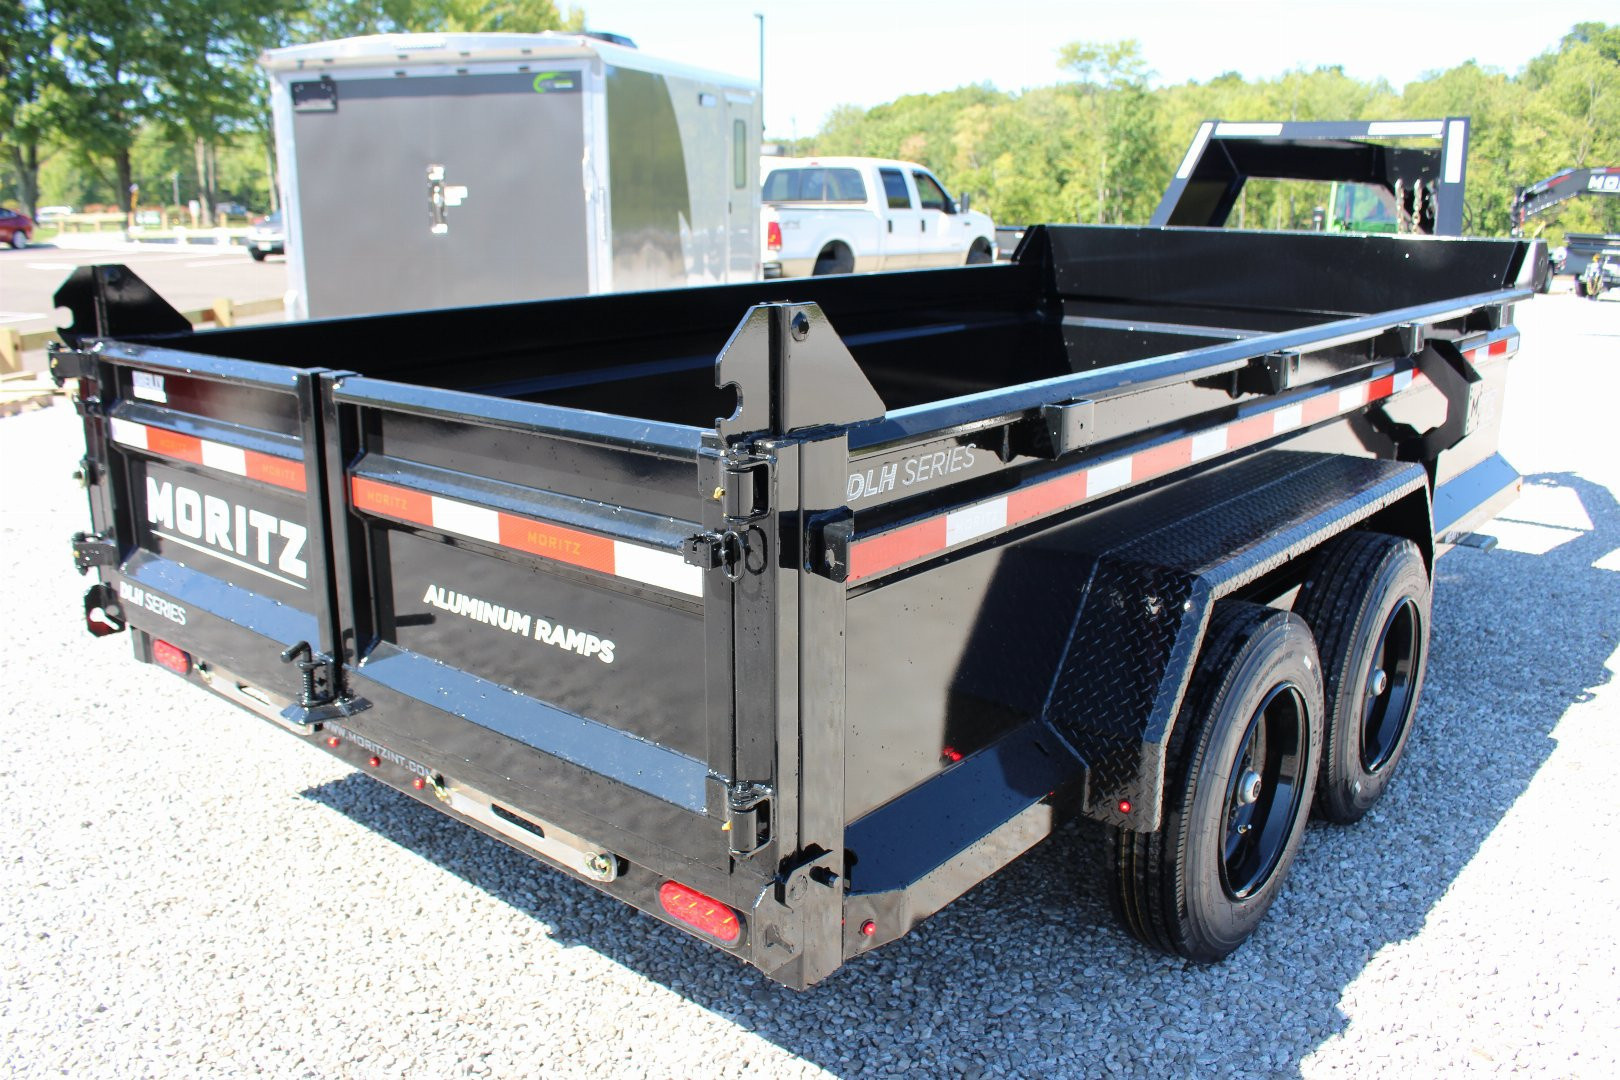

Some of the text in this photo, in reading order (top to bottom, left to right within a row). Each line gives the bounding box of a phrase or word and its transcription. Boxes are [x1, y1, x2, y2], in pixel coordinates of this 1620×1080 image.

[1587, 174, 1620, 190] MO
[847, 443, 977, 502] DLH SERIES
[366, 491, 408, 511] MORITZ
[146, 476, 307, 580] MORITZ
[527, 530, 582, 556] MORITZ
[144, 592, 186, 626] SERIES
[423, 584, 616, 665] ALUMINUM RAMPS
